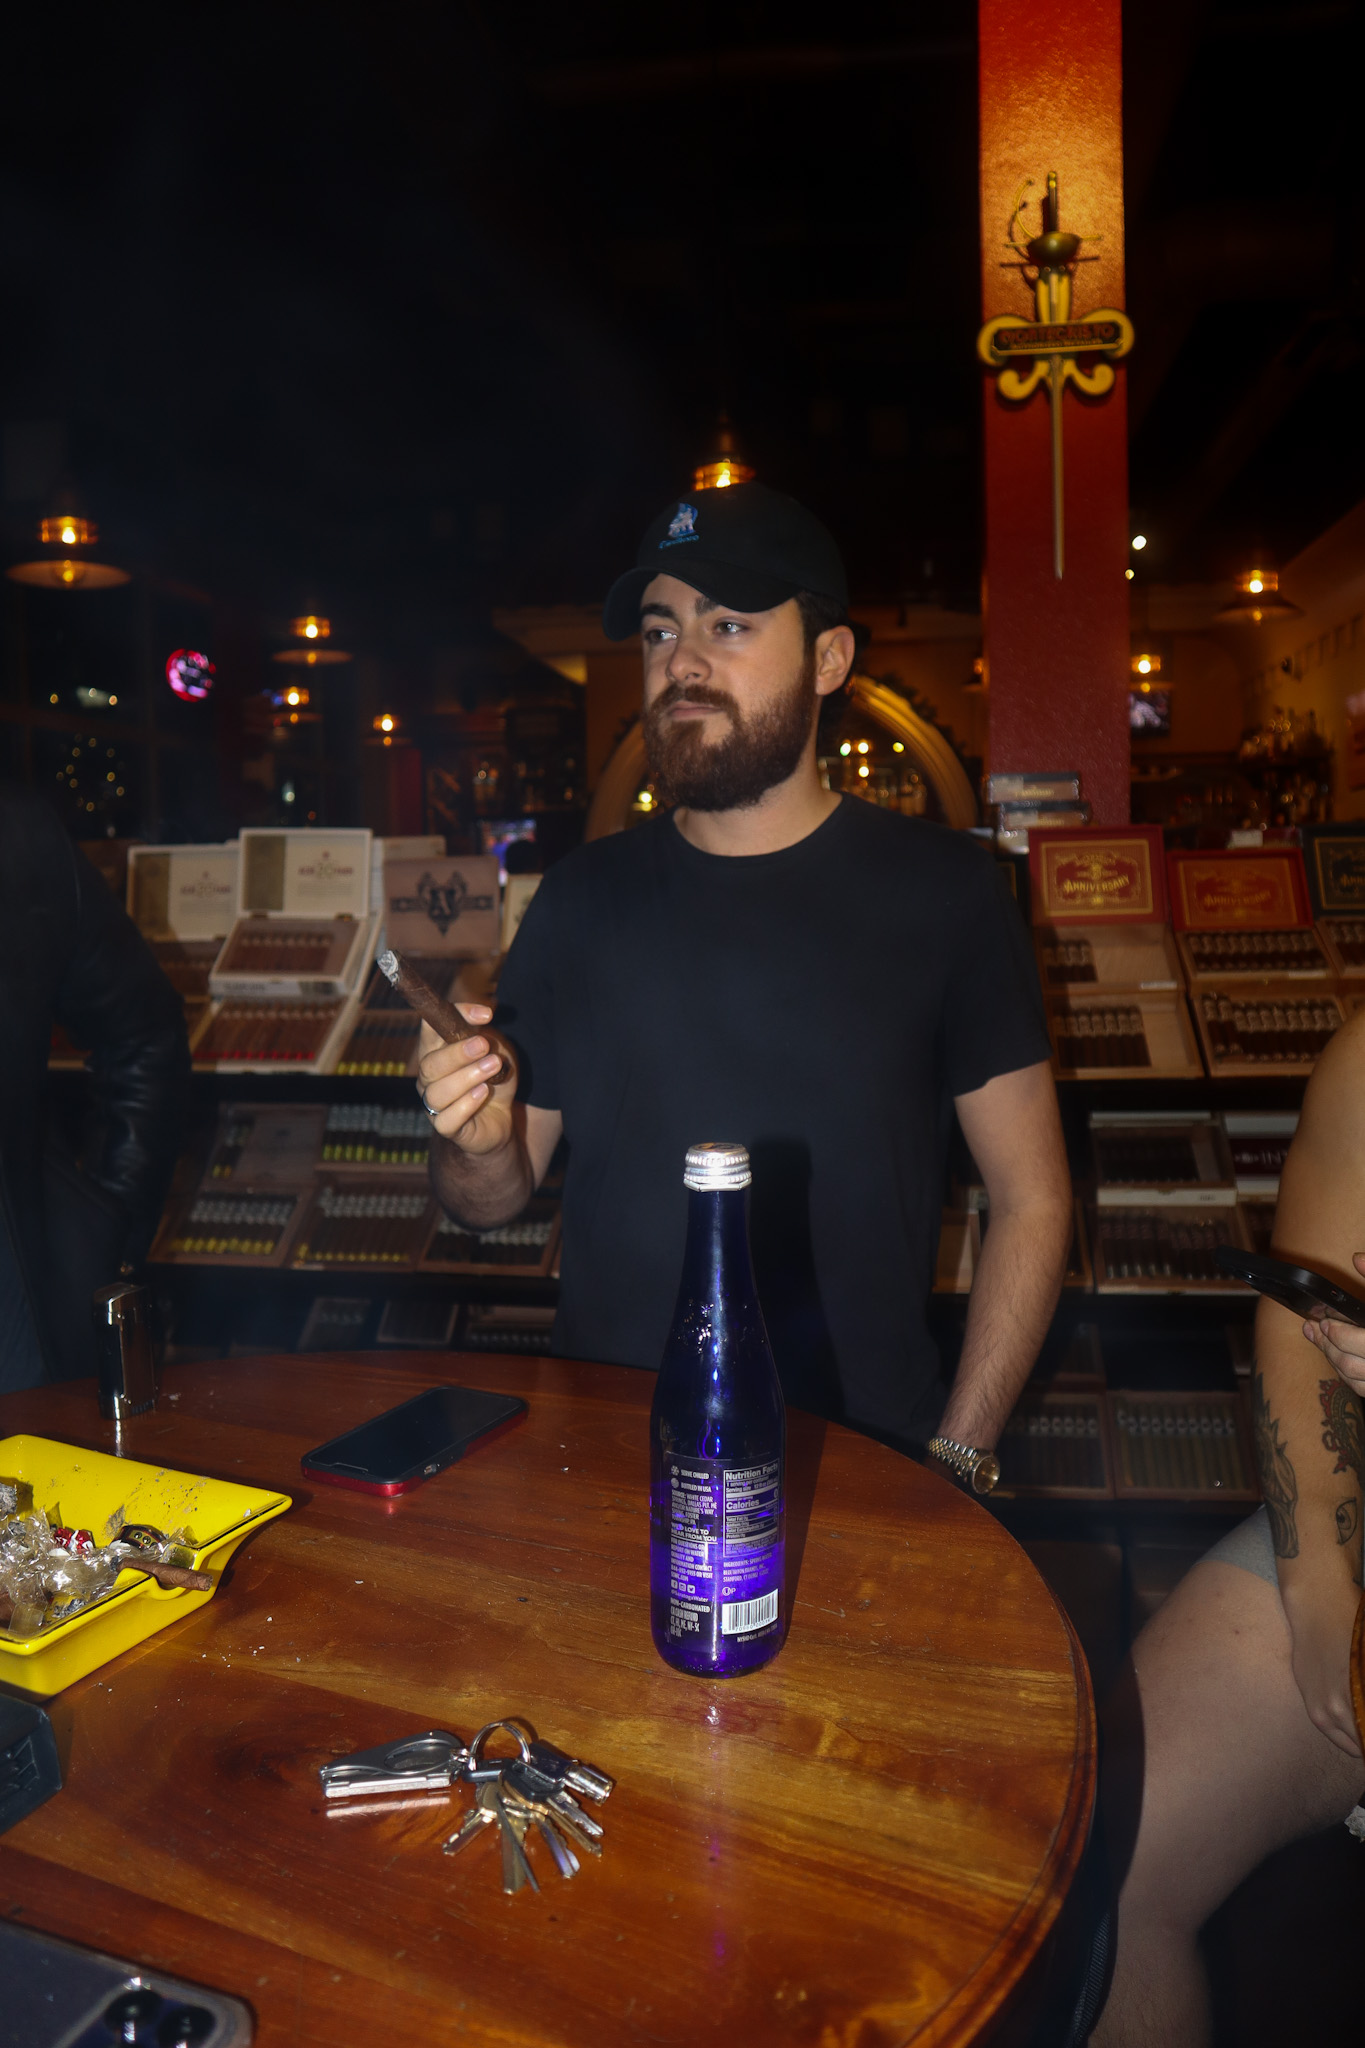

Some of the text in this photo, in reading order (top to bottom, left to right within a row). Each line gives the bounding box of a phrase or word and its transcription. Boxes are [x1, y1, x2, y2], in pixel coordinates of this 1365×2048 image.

[1063, 874, 1130, 894] ANNIVERSARY
[726, 1462, 778, 1480] Nutrition Facts
[726, 1499, 760, 1510] Calories
[685, 1525, 699, 1534] LOVE
[685, 1533, 702, 1541] FROM
[670, 1597, 710, 1612] NON-CARBONATED
